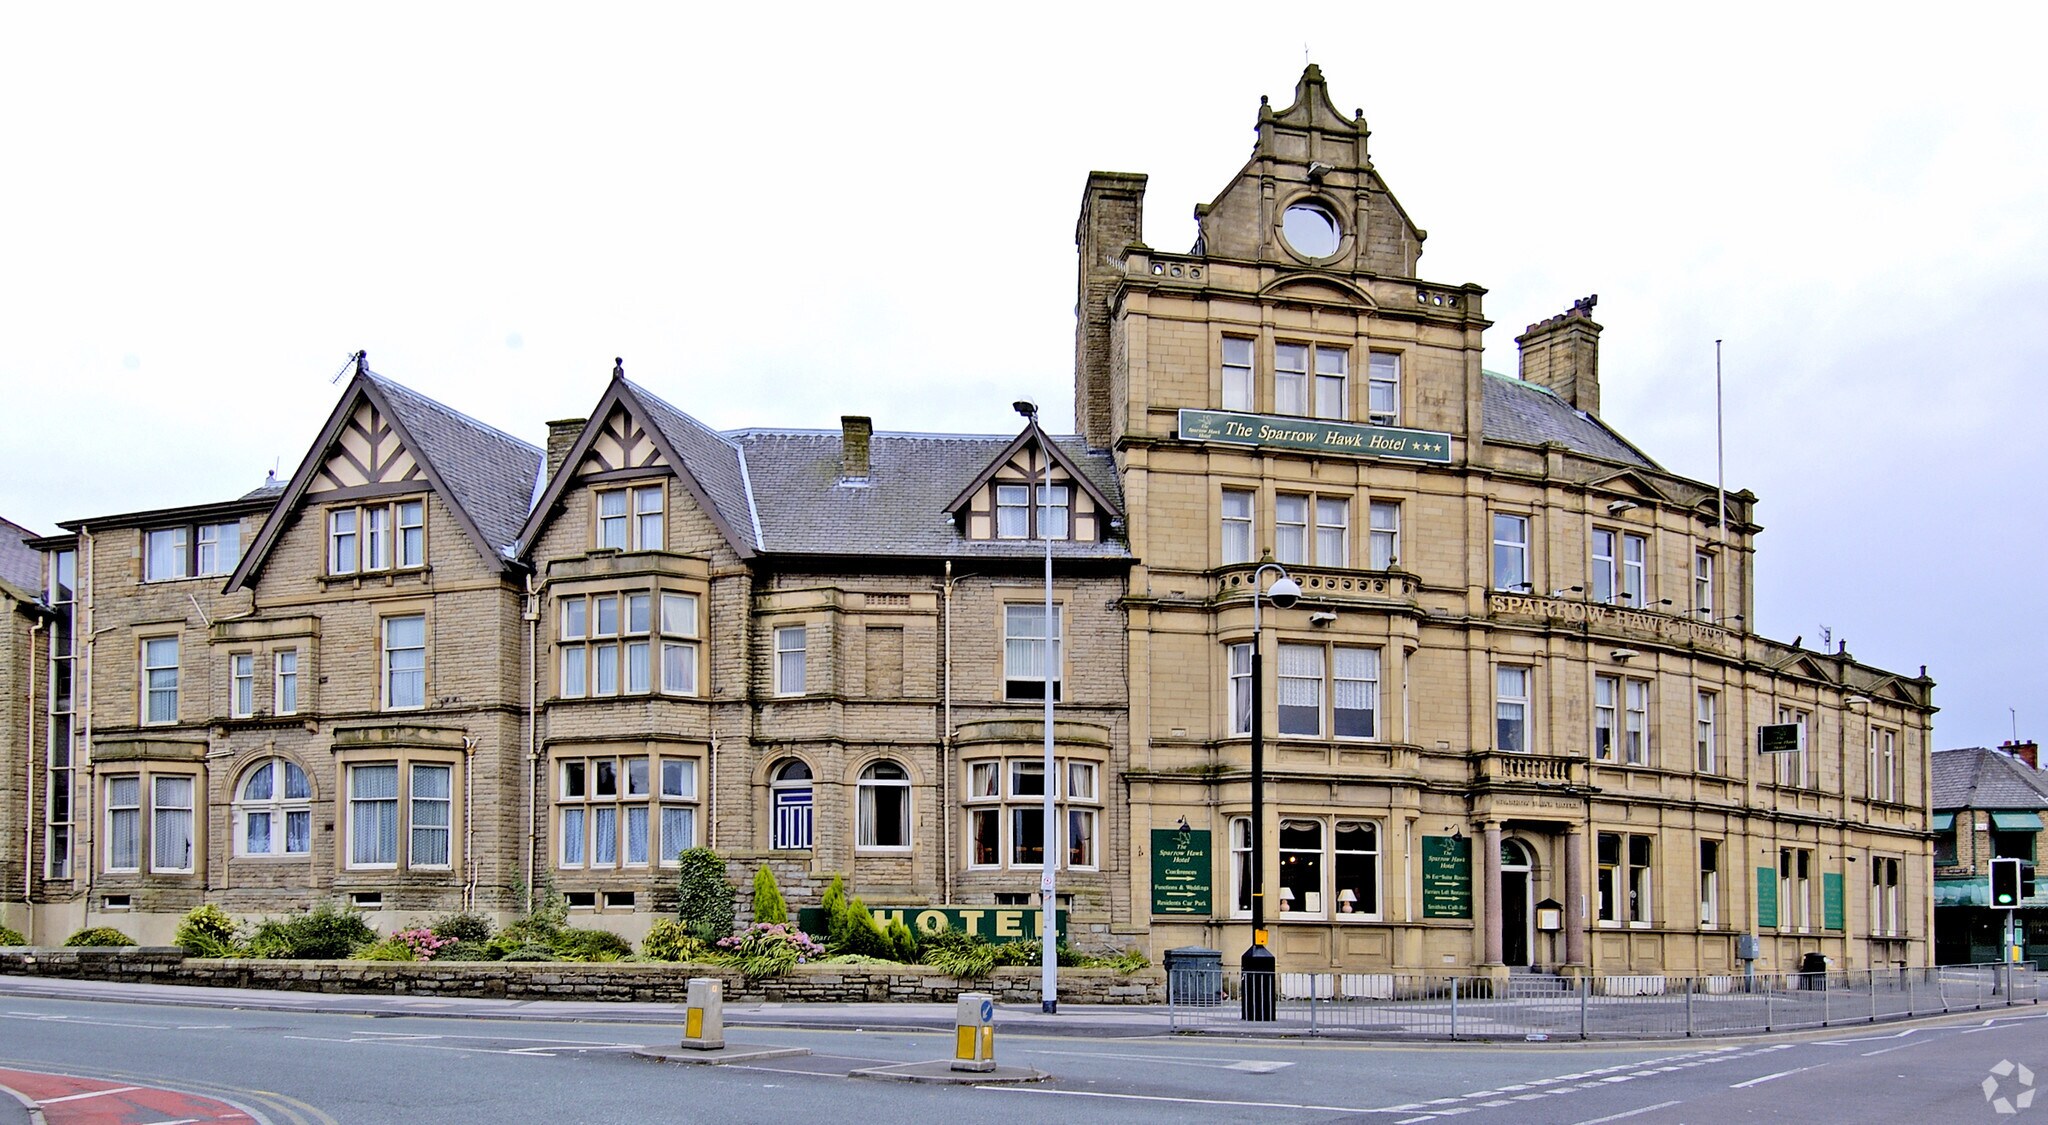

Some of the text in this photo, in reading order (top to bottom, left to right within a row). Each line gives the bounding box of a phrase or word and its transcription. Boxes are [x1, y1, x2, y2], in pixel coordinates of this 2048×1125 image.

[1225, 421, 1407, 451] The Sparrow Hawk Hotel
[1491, 595, 1730, 648] SPARROW HAWK HOTEL
[873, 910, 1059, 937] HOTEL
